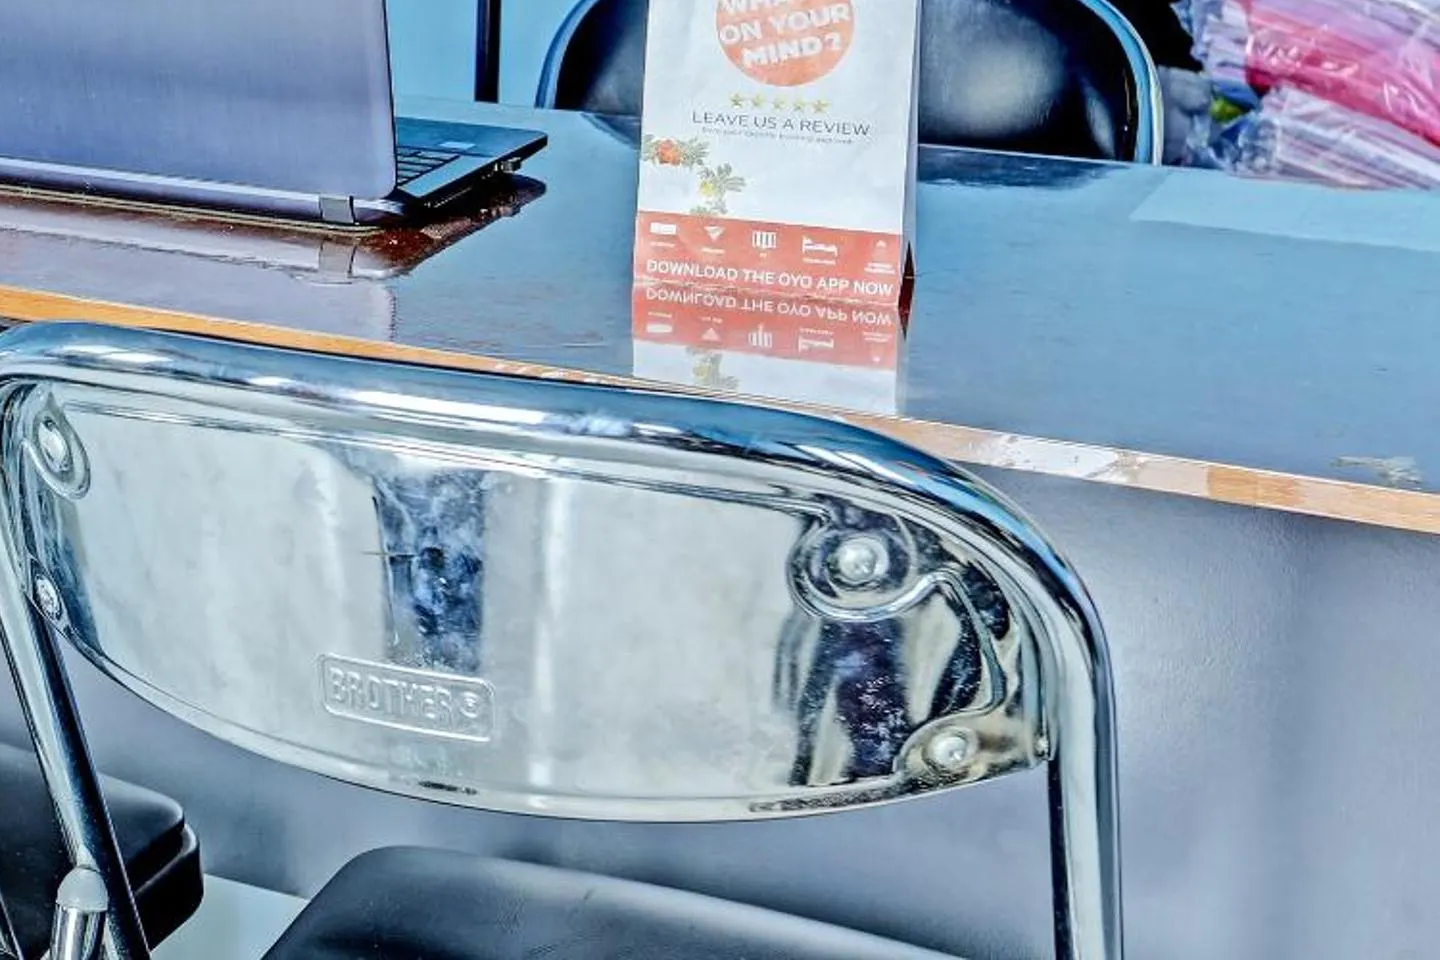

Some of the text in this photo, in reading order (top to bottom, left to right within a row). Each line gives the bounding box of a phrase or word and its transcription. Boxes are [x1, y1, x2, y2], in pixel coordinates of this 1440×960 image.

[719, 3, 850, 45] ON YOUR
[741, 31, 841, 69] MIND?
[692, 111, 749, 128] LEAVE
[753, 116, 777, 130] US
[782, 118, 794, 131] A
[799, 119, 871, 136] REVIEW
[646, 259, 894, 296] DOWNLOAD THE OYO APP NOW
